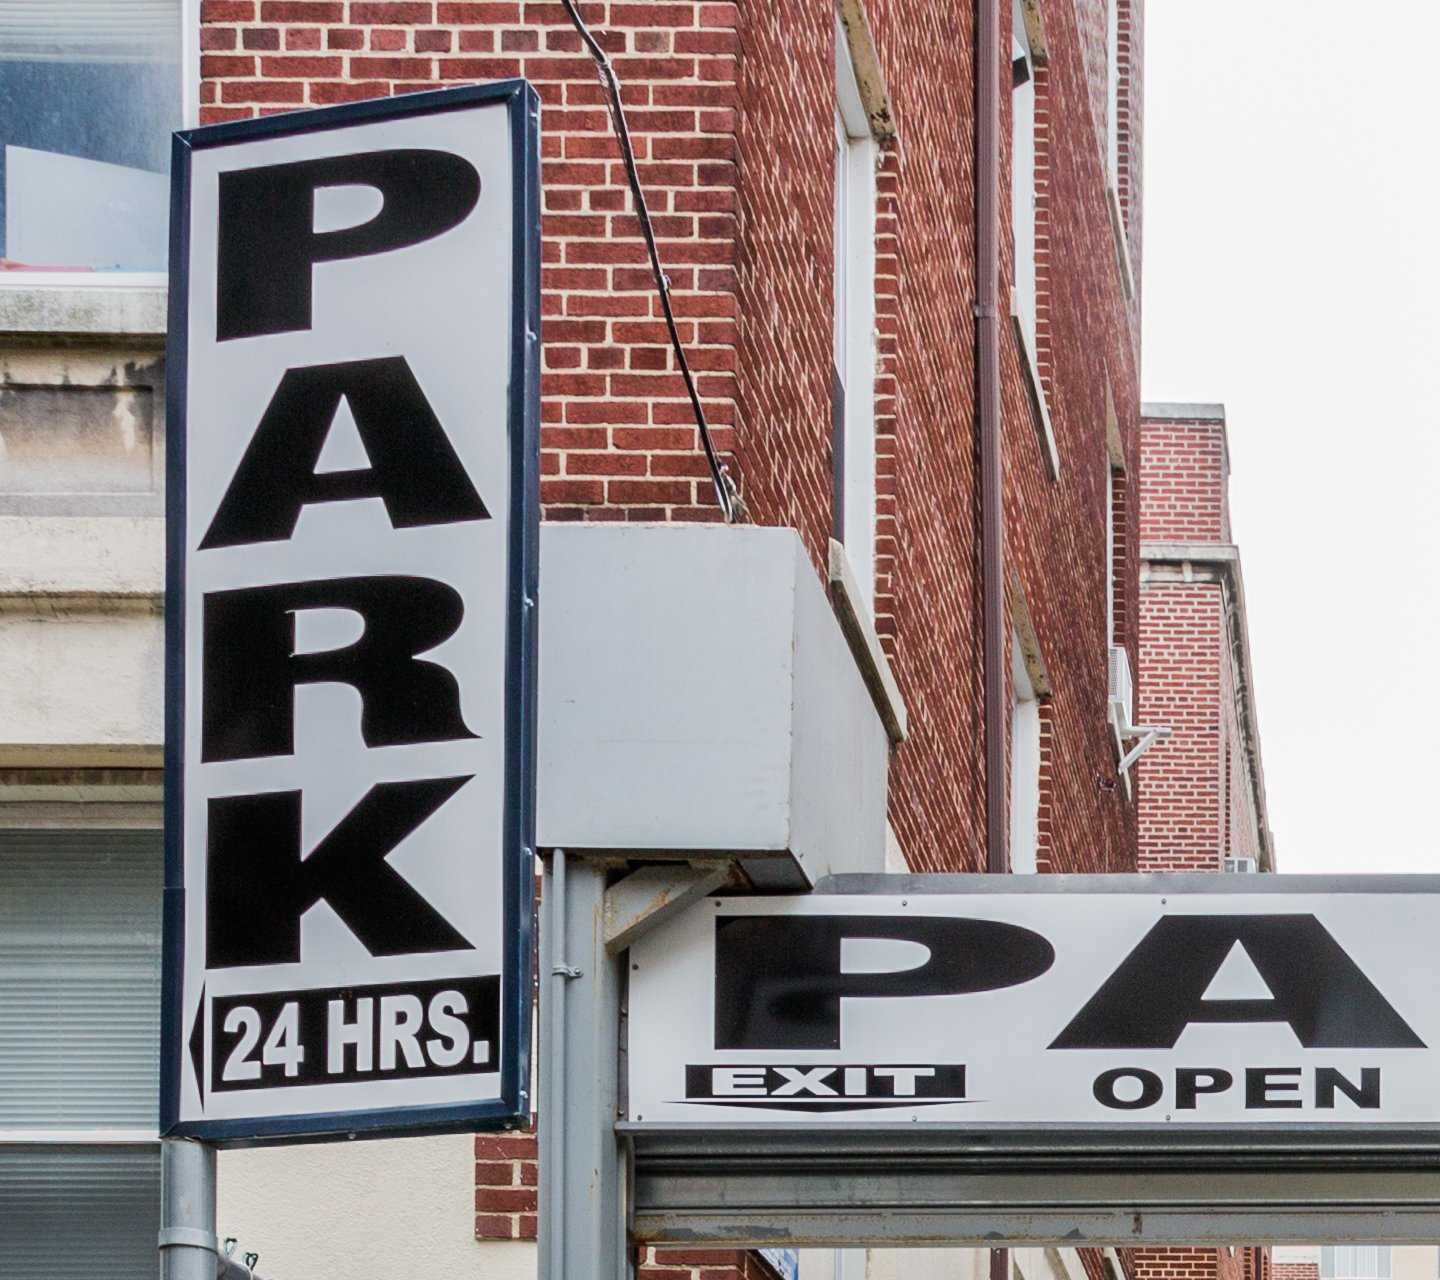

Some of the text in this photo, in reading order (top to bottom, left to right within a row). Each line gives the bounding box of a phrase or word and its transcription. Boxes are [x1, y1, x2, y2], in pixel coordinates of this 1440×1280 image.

[197, 148, 493, 969] PARK
[221, 989, 490, 1082] 24 HRS.
[710, 1065, 936, 1097] EXIT
[1092, 1066, 1382, 1110] OPEN
